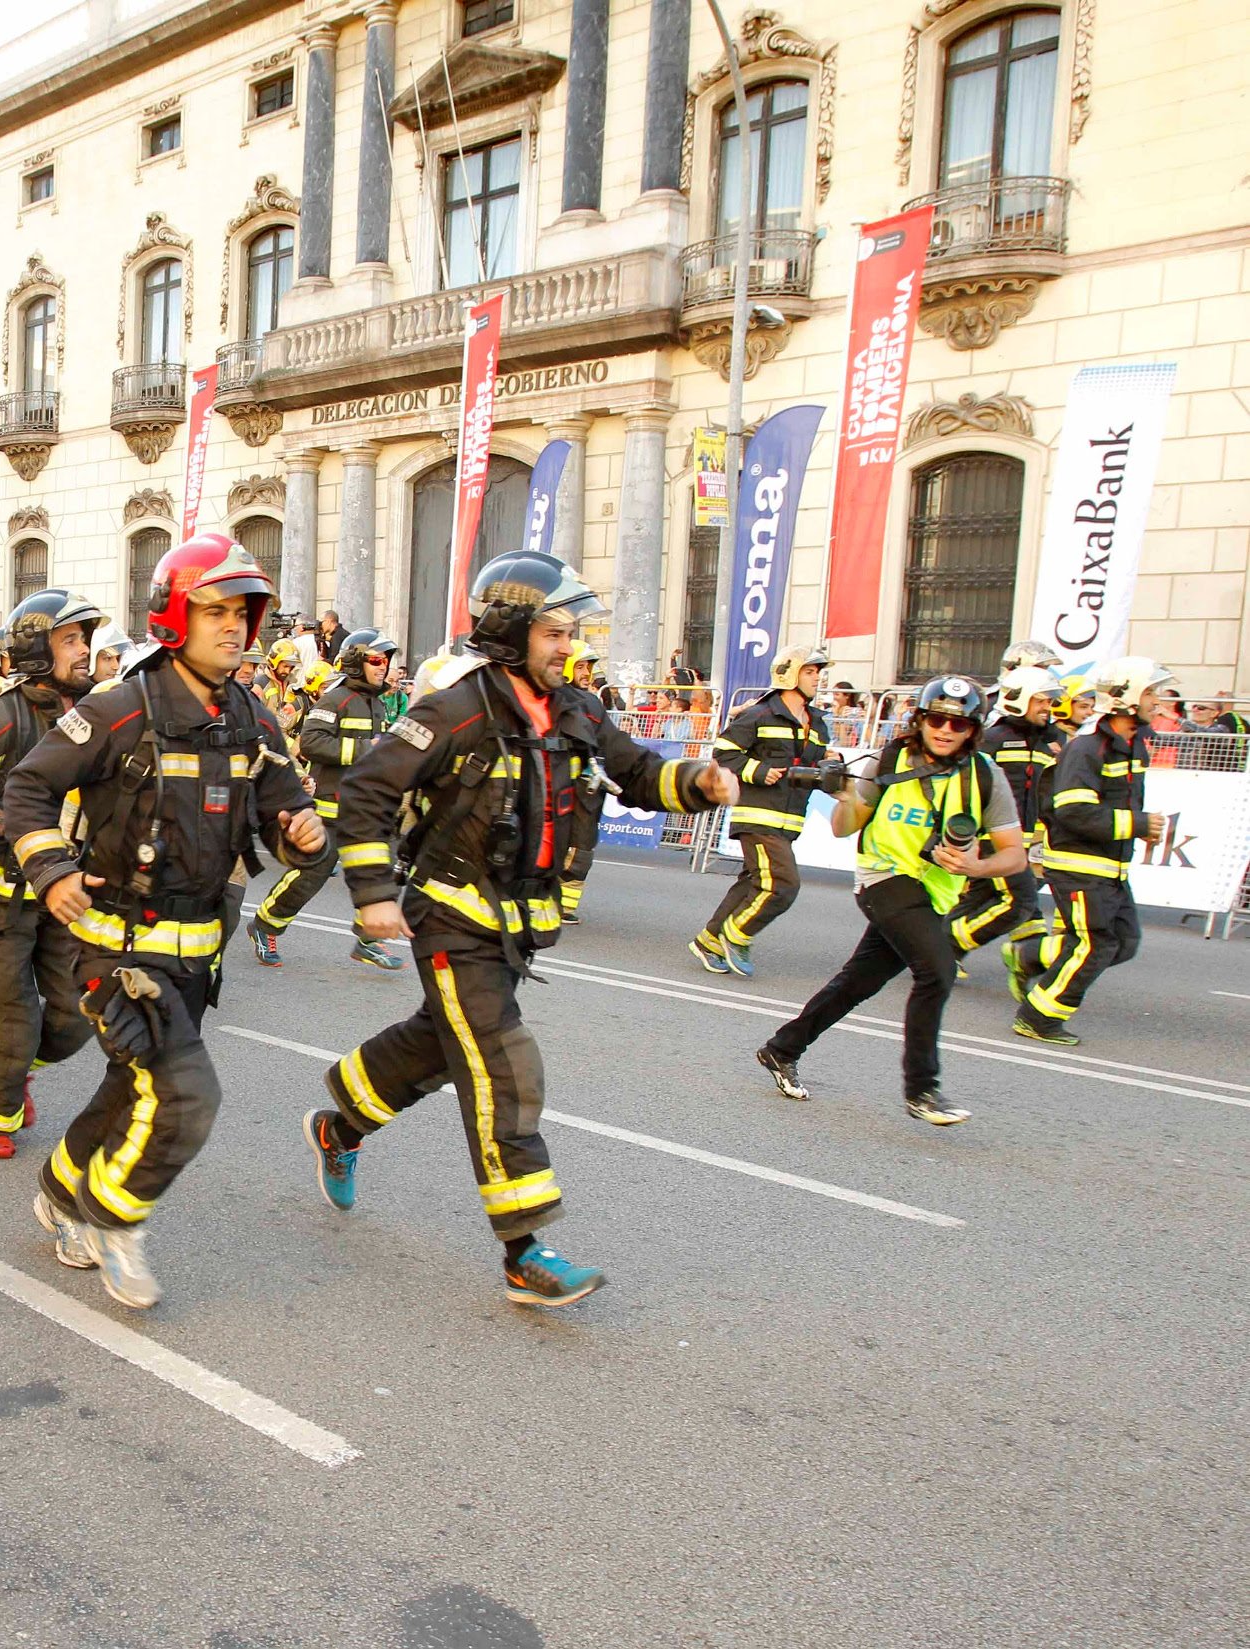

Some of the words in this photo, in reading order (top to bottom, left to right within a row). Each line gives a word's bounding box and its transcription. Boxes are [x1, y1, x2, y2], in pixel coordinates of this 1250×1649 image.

[875, 270, 916, 433] BARCELONA
[311, 389, 430, 426] DELEGACION
[439, 383, 462, 407] DE
[493, 360, 610, 398] GOBIERNO
[847, 347, 868, 440] CURSA
[1054, 421, 1135, 651] CaixaBank
[952, 682, 961, 692] 8
[597, 822, 654, 836] -sport.com
